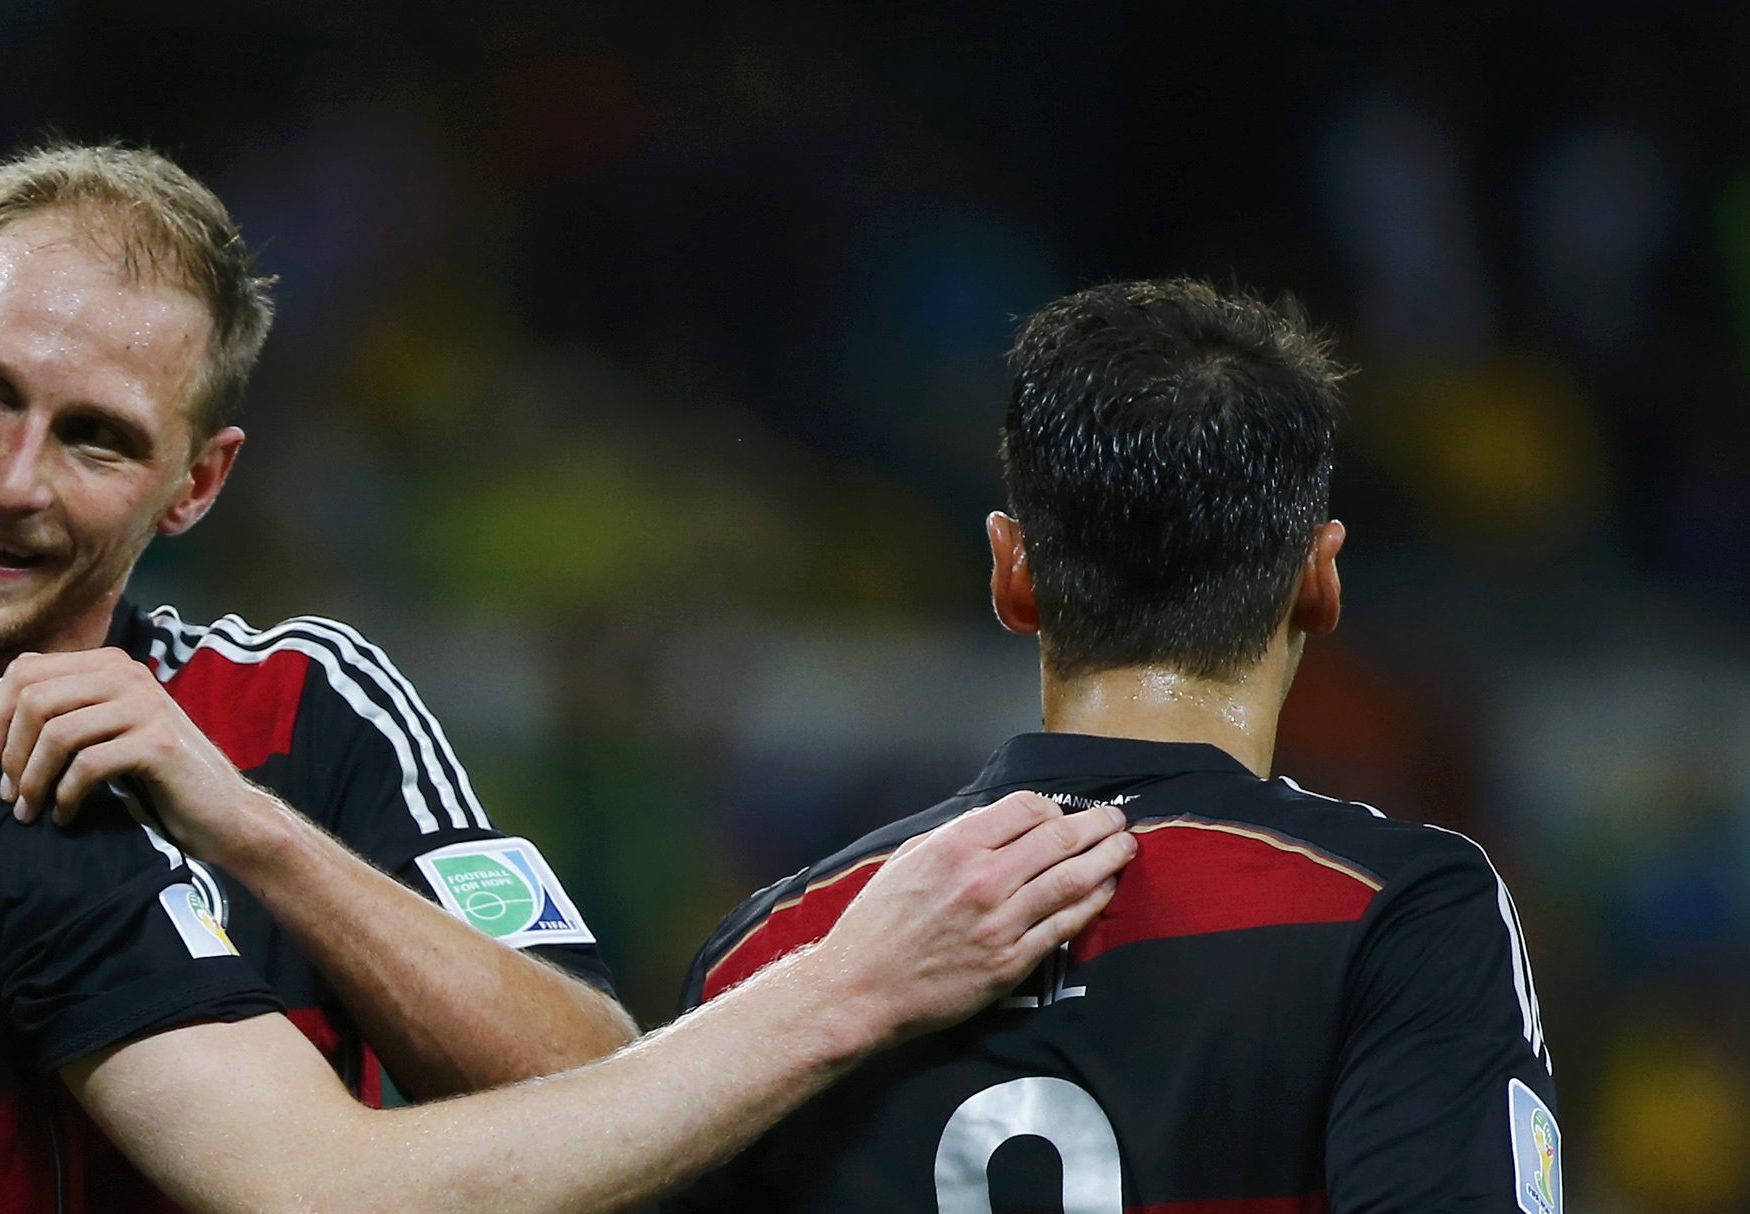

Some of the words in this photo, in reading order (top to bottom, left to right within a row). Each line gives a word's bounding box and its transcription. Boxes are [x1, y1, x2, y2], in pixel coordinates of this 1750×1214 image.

[447, 869, 511, 885] FOOTBALL
[453, 880, 480, 894] FOR
[481, 877, 514, 889] HOPE
[538, 920, 568, 930] FIFA
